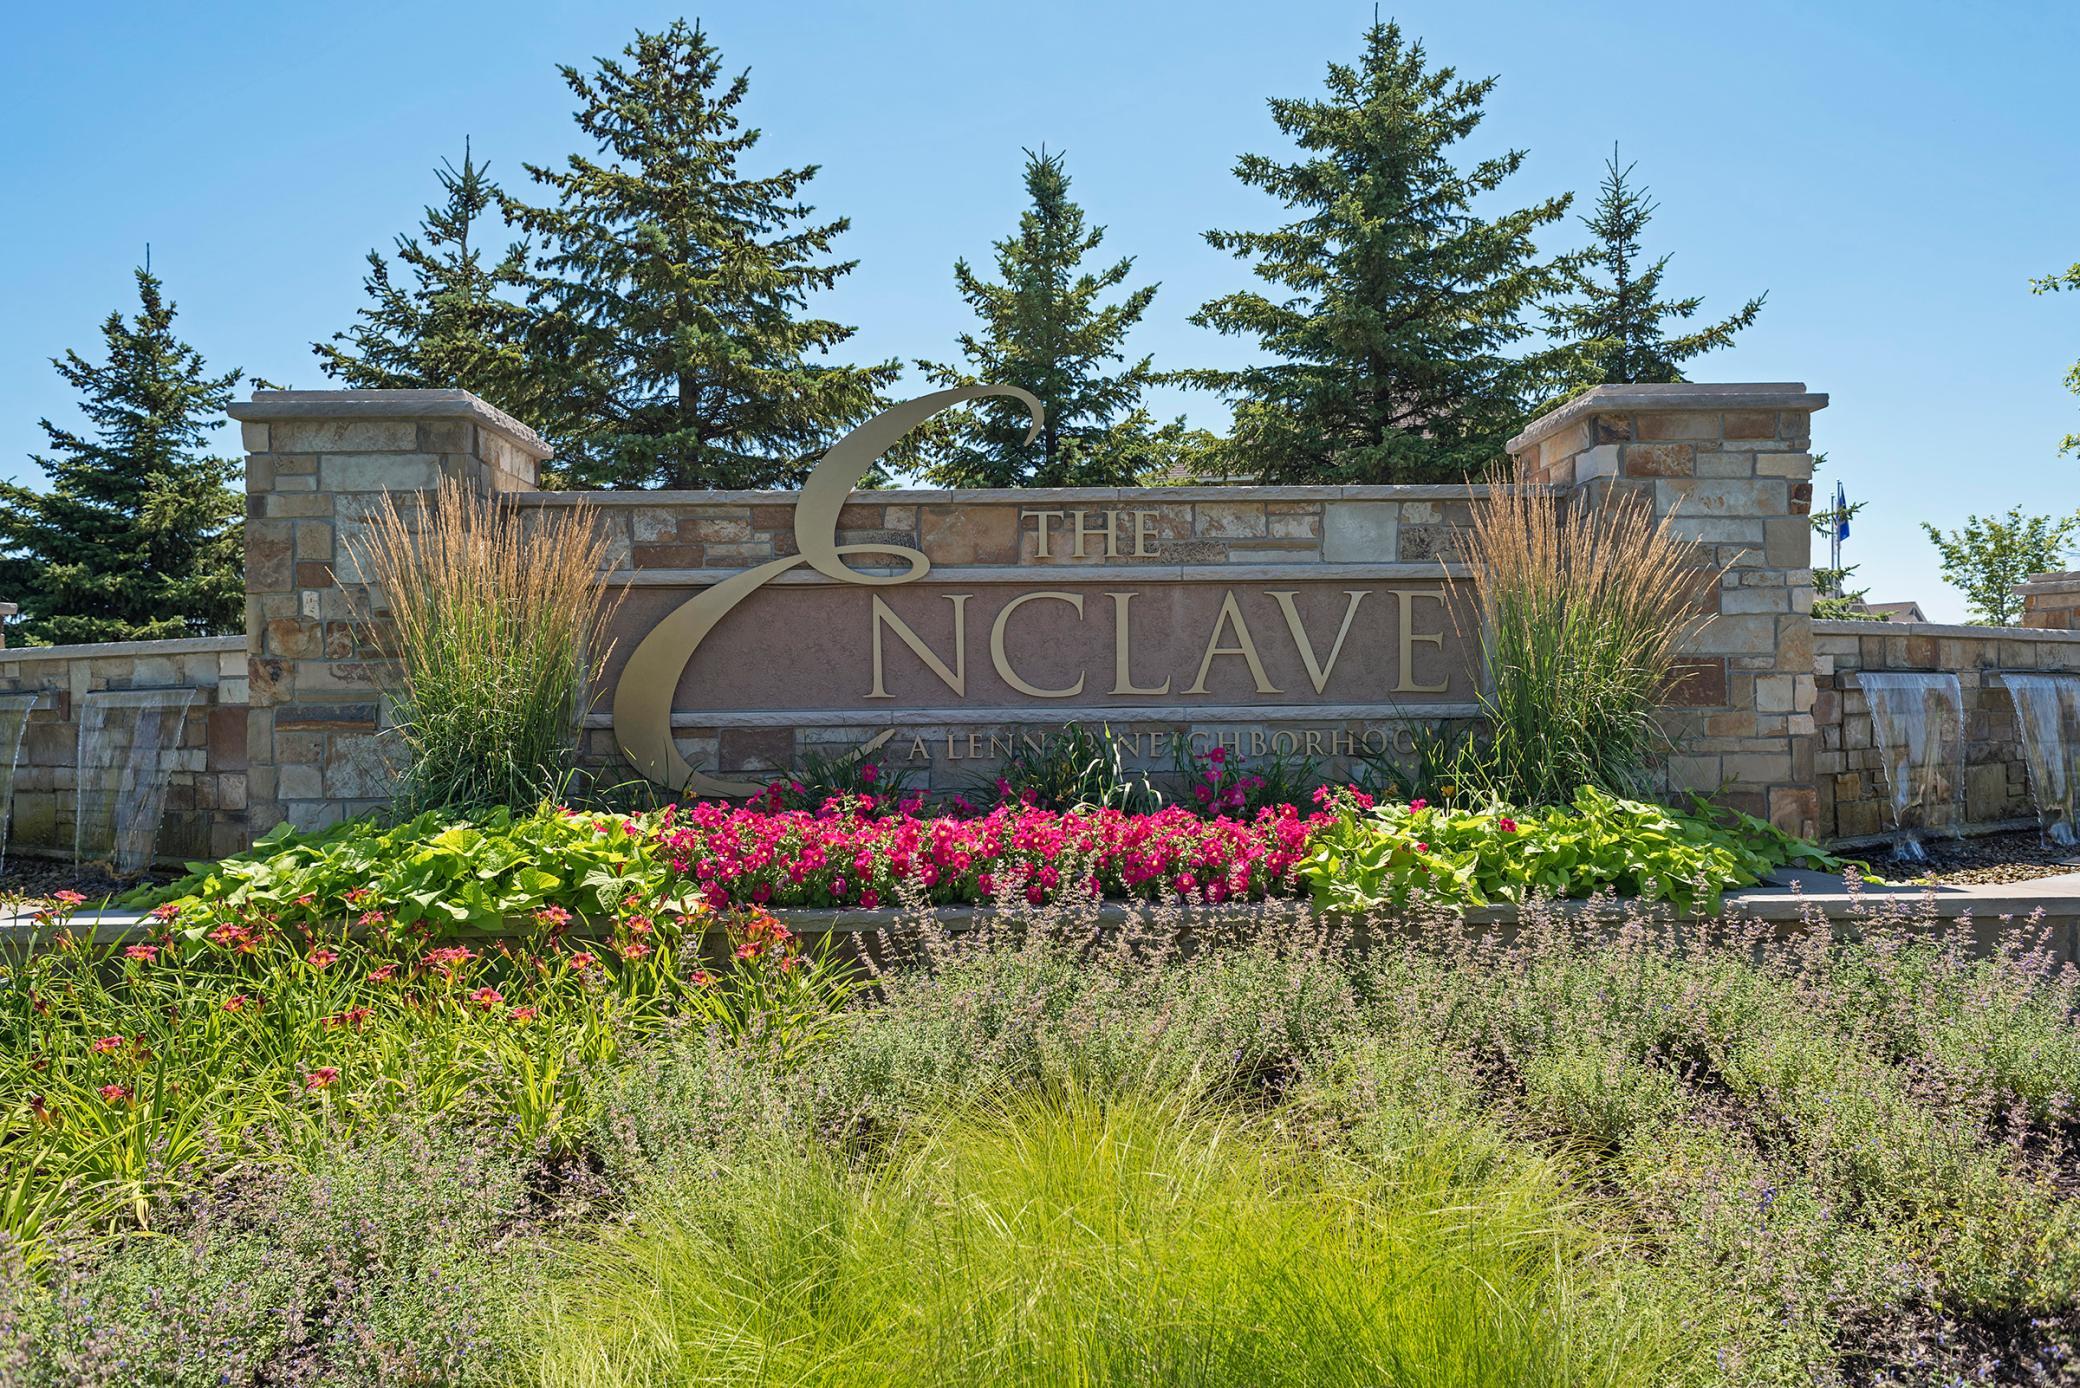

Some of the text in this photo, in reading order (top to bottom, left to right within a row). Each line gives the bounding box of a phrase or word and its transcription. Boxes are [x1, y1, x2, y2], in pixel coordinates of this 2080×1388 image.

[1021, 509, 1161, 558] THE
[613, 384, 1450, 798] ENCLAVE
[907, 728, 1417, 760] A LENN NEIGHBORHOO
